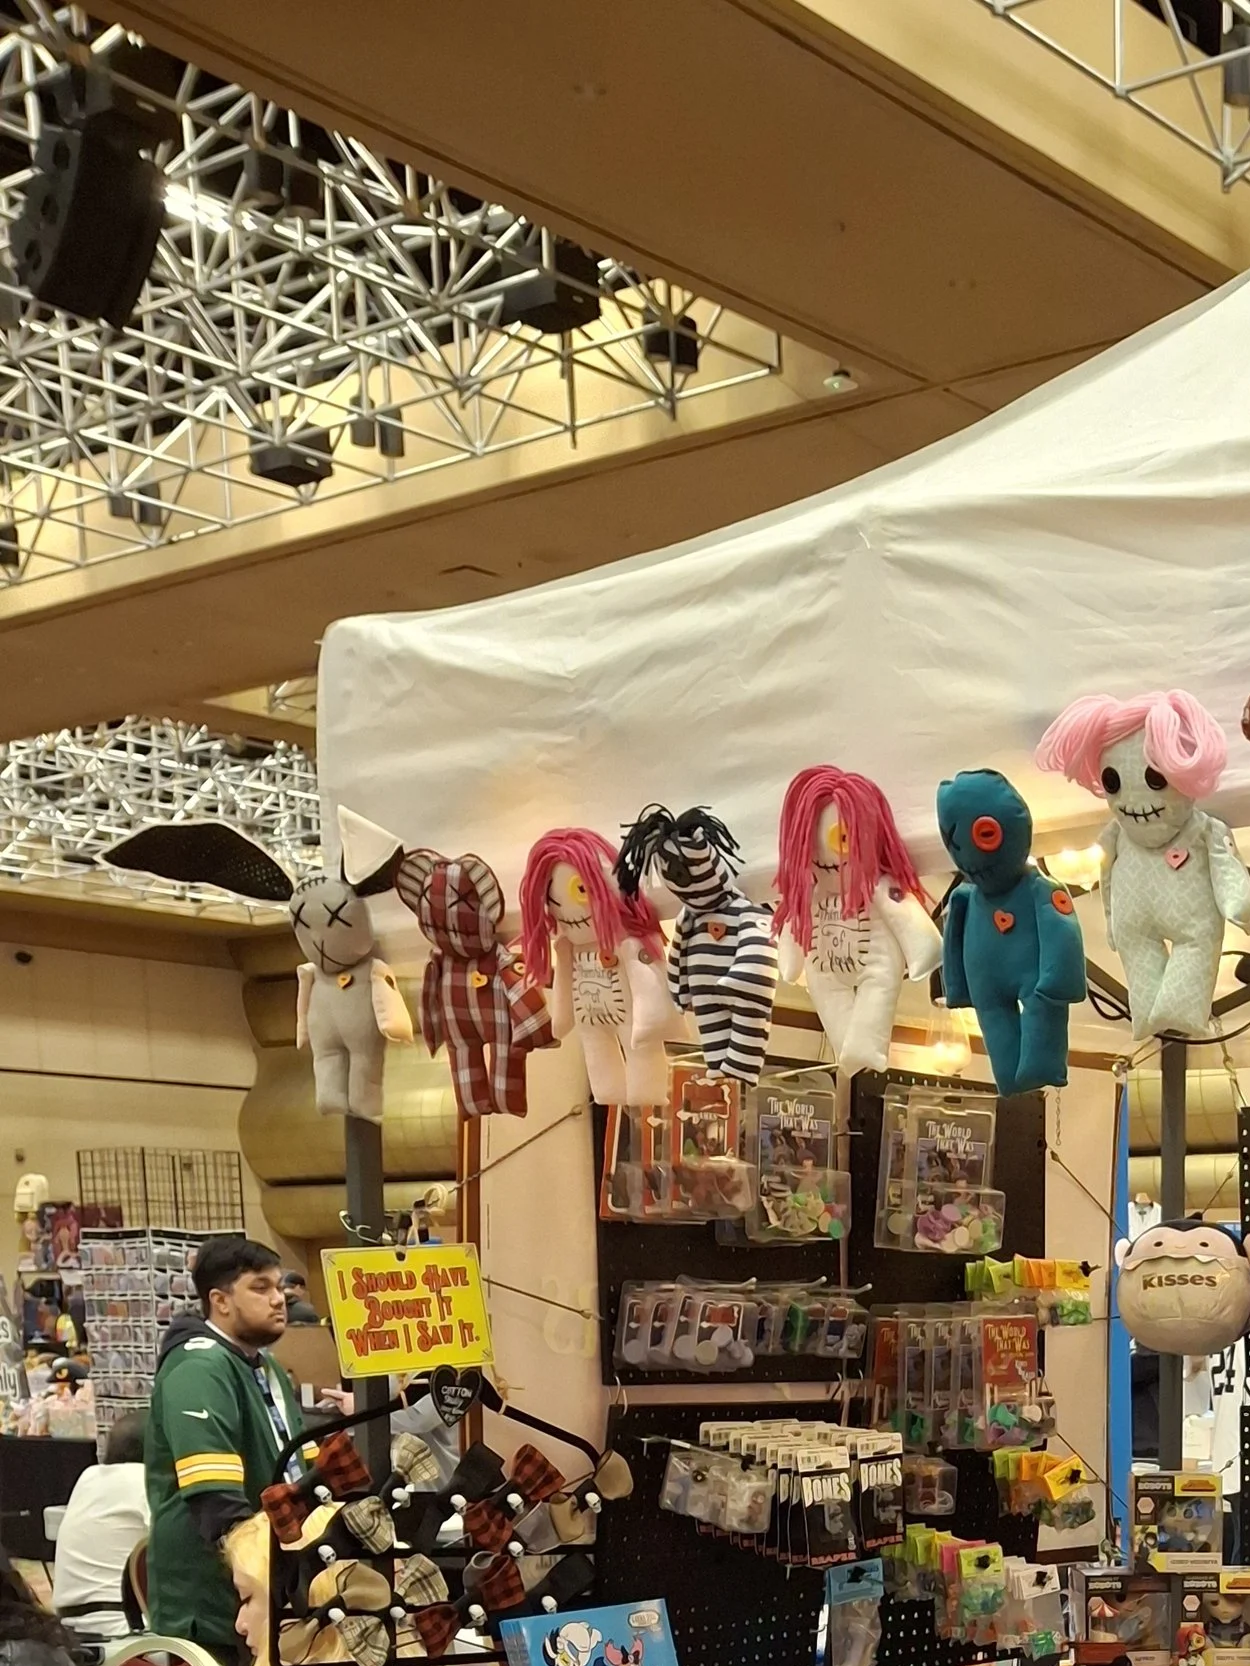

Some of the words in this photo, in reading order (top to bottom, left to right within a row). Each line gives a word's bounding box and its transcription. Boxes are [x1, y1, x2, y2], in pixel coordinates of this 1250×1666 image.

[337, 1271, 347, 1300] I
[352, 1267, 417, 1299] SHOULD
[422, 1265, 469, 1293] HAVE
[364, 1296, 431, 1329] BOUGHT
[436, 1290, 452, 1321] IT
[346, 1324, 399, 1357] WHEN
[403, 1324, 412, 1353] I
[417, 1320, 453, 1352] SAW
[458, 1319, 480, 1348] IT.
[802, 1472, 851, 1508] BONES
[860, 1458, 902, 1493] BONES
